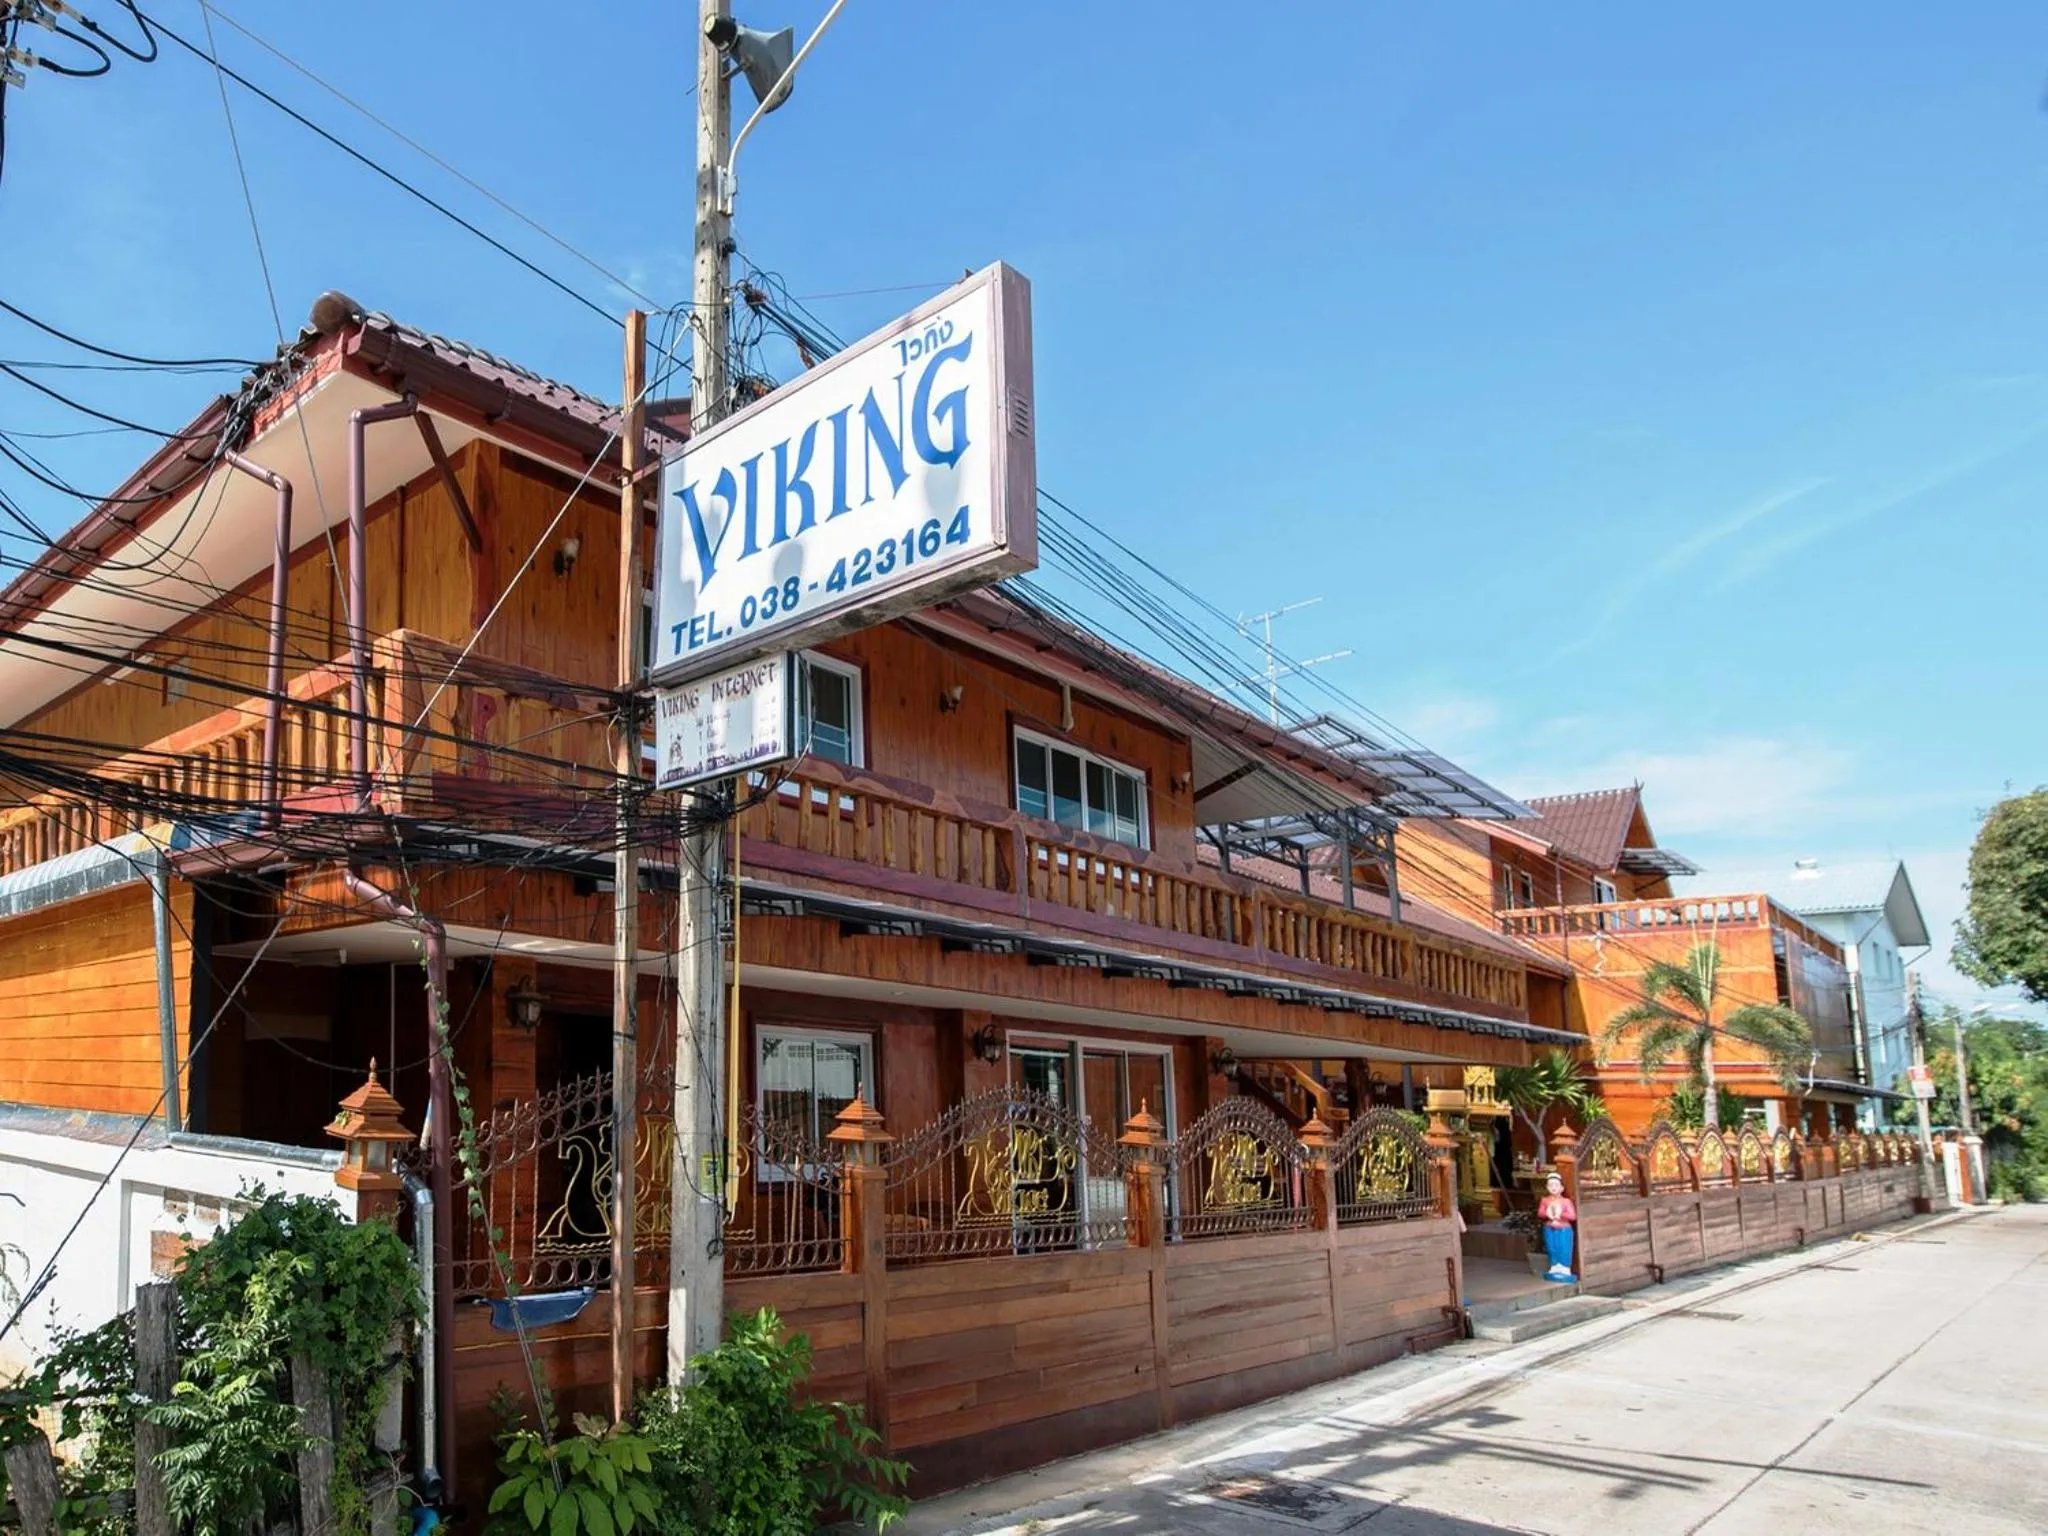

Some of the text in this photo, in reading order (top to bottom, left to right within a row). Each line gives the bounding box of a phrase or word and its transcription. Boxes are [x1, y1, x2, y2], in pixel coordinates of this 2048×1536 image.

[673, 330, 973, 594] VIKING
[672, 611, 733, 655] TEL.
[661, 662, 776, 718] VIKING INTERNET
